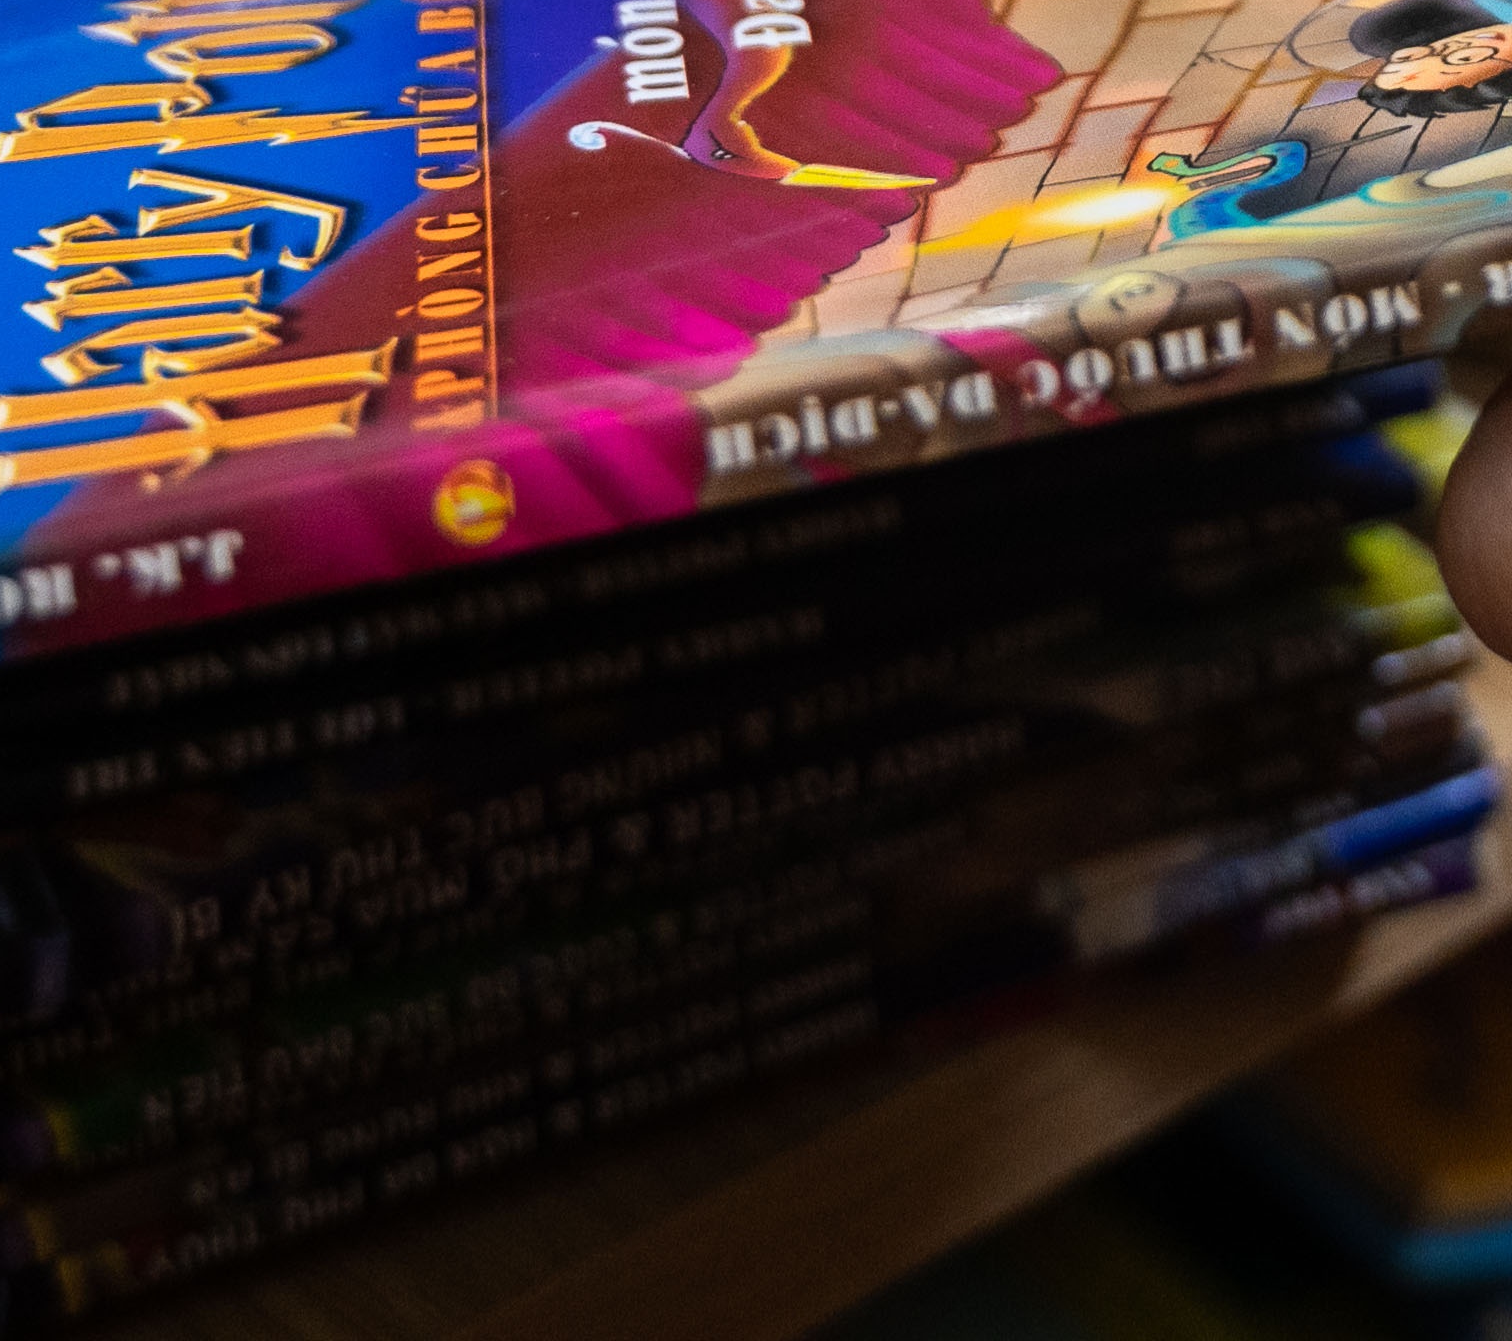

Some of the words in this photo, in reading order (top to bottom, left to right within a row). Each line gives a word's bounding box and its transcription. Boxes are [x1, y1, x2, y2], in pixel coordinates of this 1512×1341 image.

[400, 45, 486, 192] CHỨA
[396, 209, 486, 379] PHÒNG
[1288, 283, 1422, 359] MÓN
[1021, 320, 1255, 423] THUỐC
[96, 528, 244, 598] J.K.
[664, 752, 861, 831] POTTER
[610, 811, 652, 857] &
